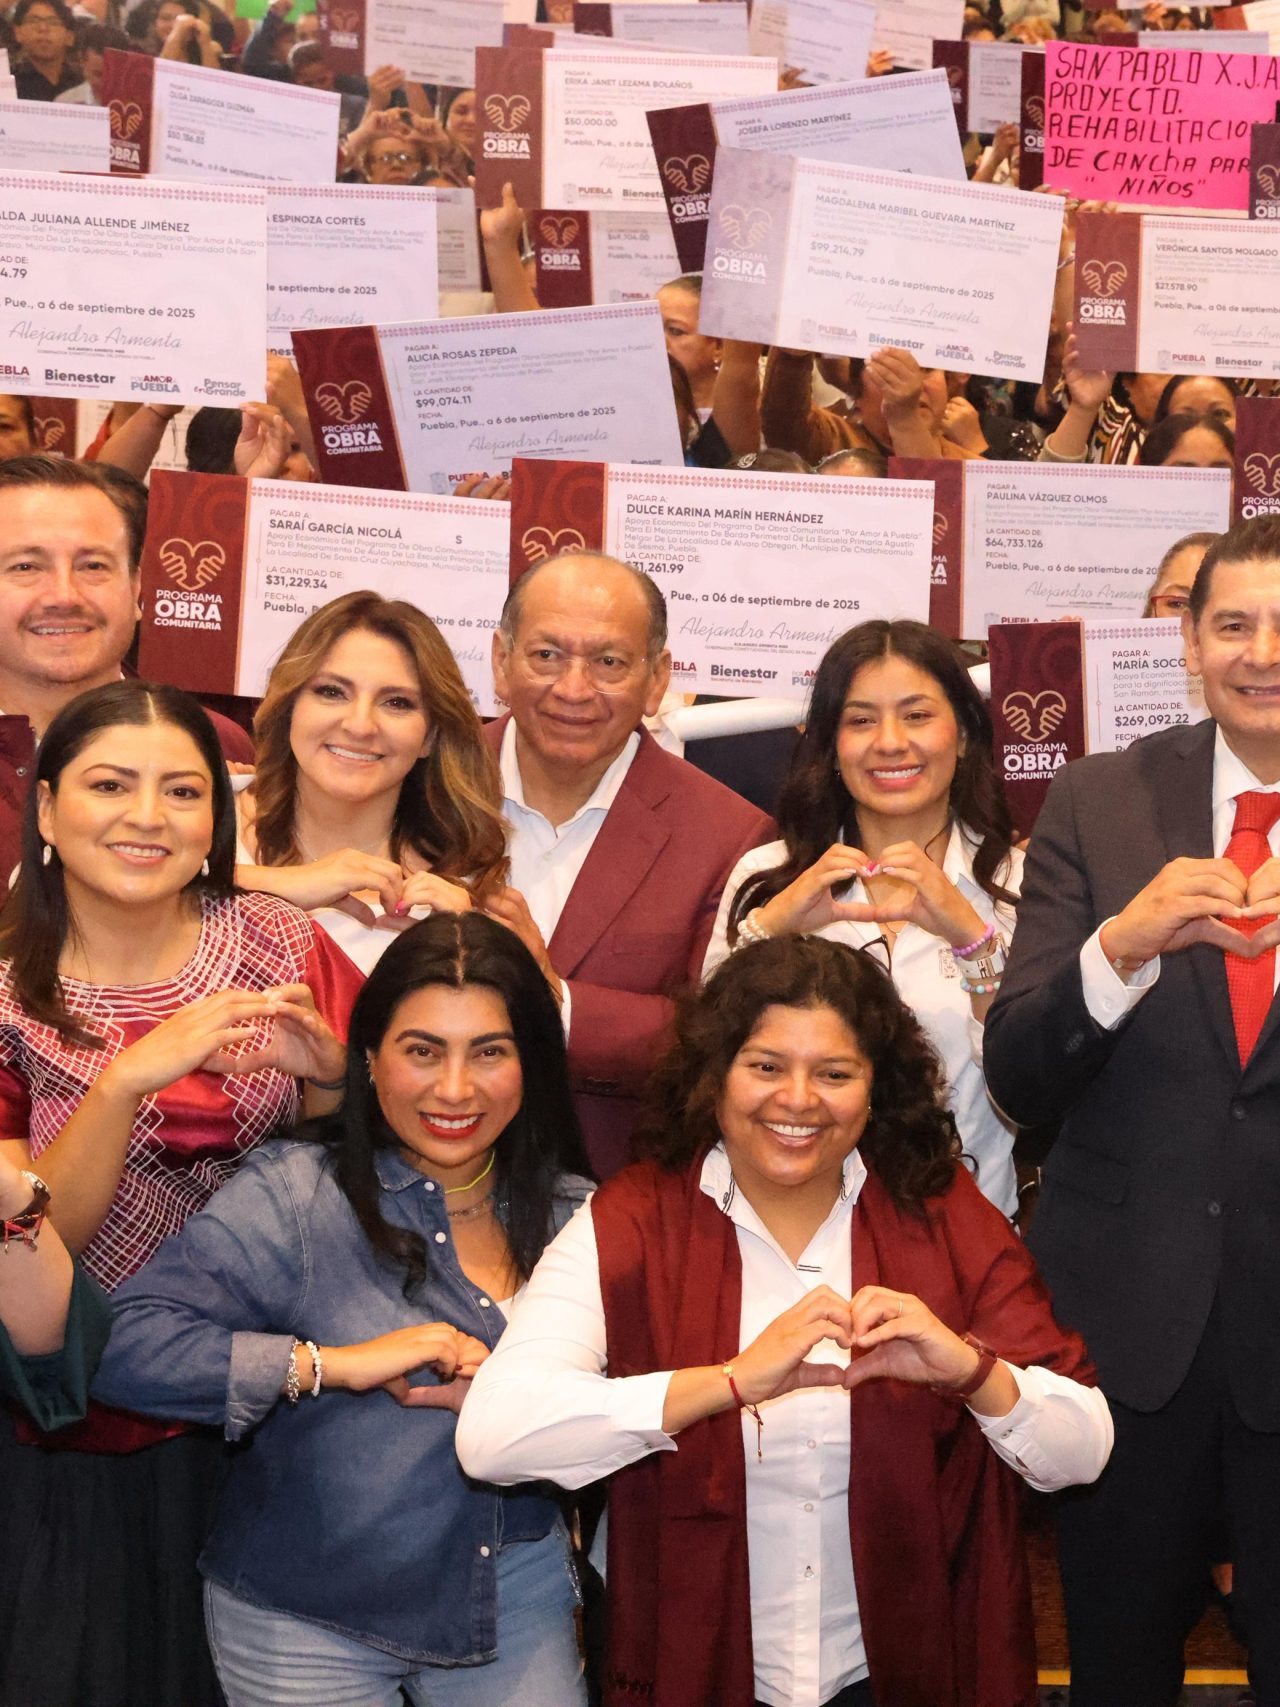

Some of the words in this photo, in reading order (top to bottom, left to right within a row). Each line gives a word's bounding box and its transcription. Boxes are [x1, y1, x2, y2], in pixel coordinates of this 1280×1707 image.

[738, 125, 768, 136] JOSEFA
[770, 119, 809, 131] LORENZO
[810, 113, 851, 124] MARTÍNEZ
[1048, 113, 1272, 143] REHABILITACIO
[1048, 146, 1083, 168] DE
[1209, 156, 1250, 174] PAR
[272, 214, 322, 224] ESPINOZA
[325, 216, 365, 226] CORTÉS
[816, 195, 875, 210] MAGDALENA
[879, 204, 918, 216] MARIBEL
[921, 210, 966, 223] GUEVARA
[969, 217, 1015, 231] MARTÍNEZ
[0, 211, 26, 221] LDA
[30, 213, 80, 224] JULIANA
[84, 216, 136, 229] ALLENDE
[140, 220, 189, 232] JIMÉNEZ
[810, 241, 864, 256] $99,214.79
[1156, 244, 1198, 252] VERÓNICA
[1201, 246, 1233, 254] SANTOS
[1235, 248, 1278, 256] MOLGADO
[713, 259, 766, 277] OBRA
[1155, 282, 1197, 291] $27,578.90
[1080, 297, 1126, 307] PROGRAMA
[1080, 305, 1125, 319] OBRA
[869, 333, 924, 349] Bienestar
[407, 353, 440, 362] ALICIA
[442, 349, 477, 359] ROSAS
[479, 346, 517, 357] ZEPEDA
[1215, 356, 1262, 366] Bienestar
[44, 369, 115, 383] Bienestar
[415, 395, 471, 408] $99,074.11
[321, 422, 378, 434] PROGRAMA
[324, 431, 381, 449] OBRA
[987, 491, 1026, 500] PAULINA
[1028, 492, 1071, 502] VÁZQUEZ
[1073, 494, 1107, 503] OLMOS
[627, 504, 664, 515] DULCE
[667, 506, 711, 517] KARINA
[714, 508, 751, 519] MARÍN
[755, 511, 823, 523] HERNÁNDEZ
[269, 519, 304, 530] SARAÍ
[357, 527, 402, 539] NICOLÁ
[624, 517, 650, 526] Apoyo
[652, 518, 696, 527] Económico
[698, 520, 711, 528] Del
[713, 521, 752, 530] Programa
[754, 523, 765, 531] De
[767, 524, 788, 532] Obra
[789, 525, 839, 535] Comunitaria
[859, 529, 880, 537] Amor
[455, 535, 462, 544] S
[985, 537, 1043, 548] $64,733.126
[266, 574, 327, 589] $31,229.34
[156, 589, 222, 603] PROGRAMA
[155, 600, 221, 621] OBRA
[154, 617, 221, 630] COMUNITARIA
[1113, 658, 1149, 670] MARÍA
[711, 664, 778, 679] Bienestar
[1115, 713, 1189, 727] $269,092.22
[1003, 742, 1067, 753] PROGRAMA
[1003, 753, 1067, 772] OBRA
